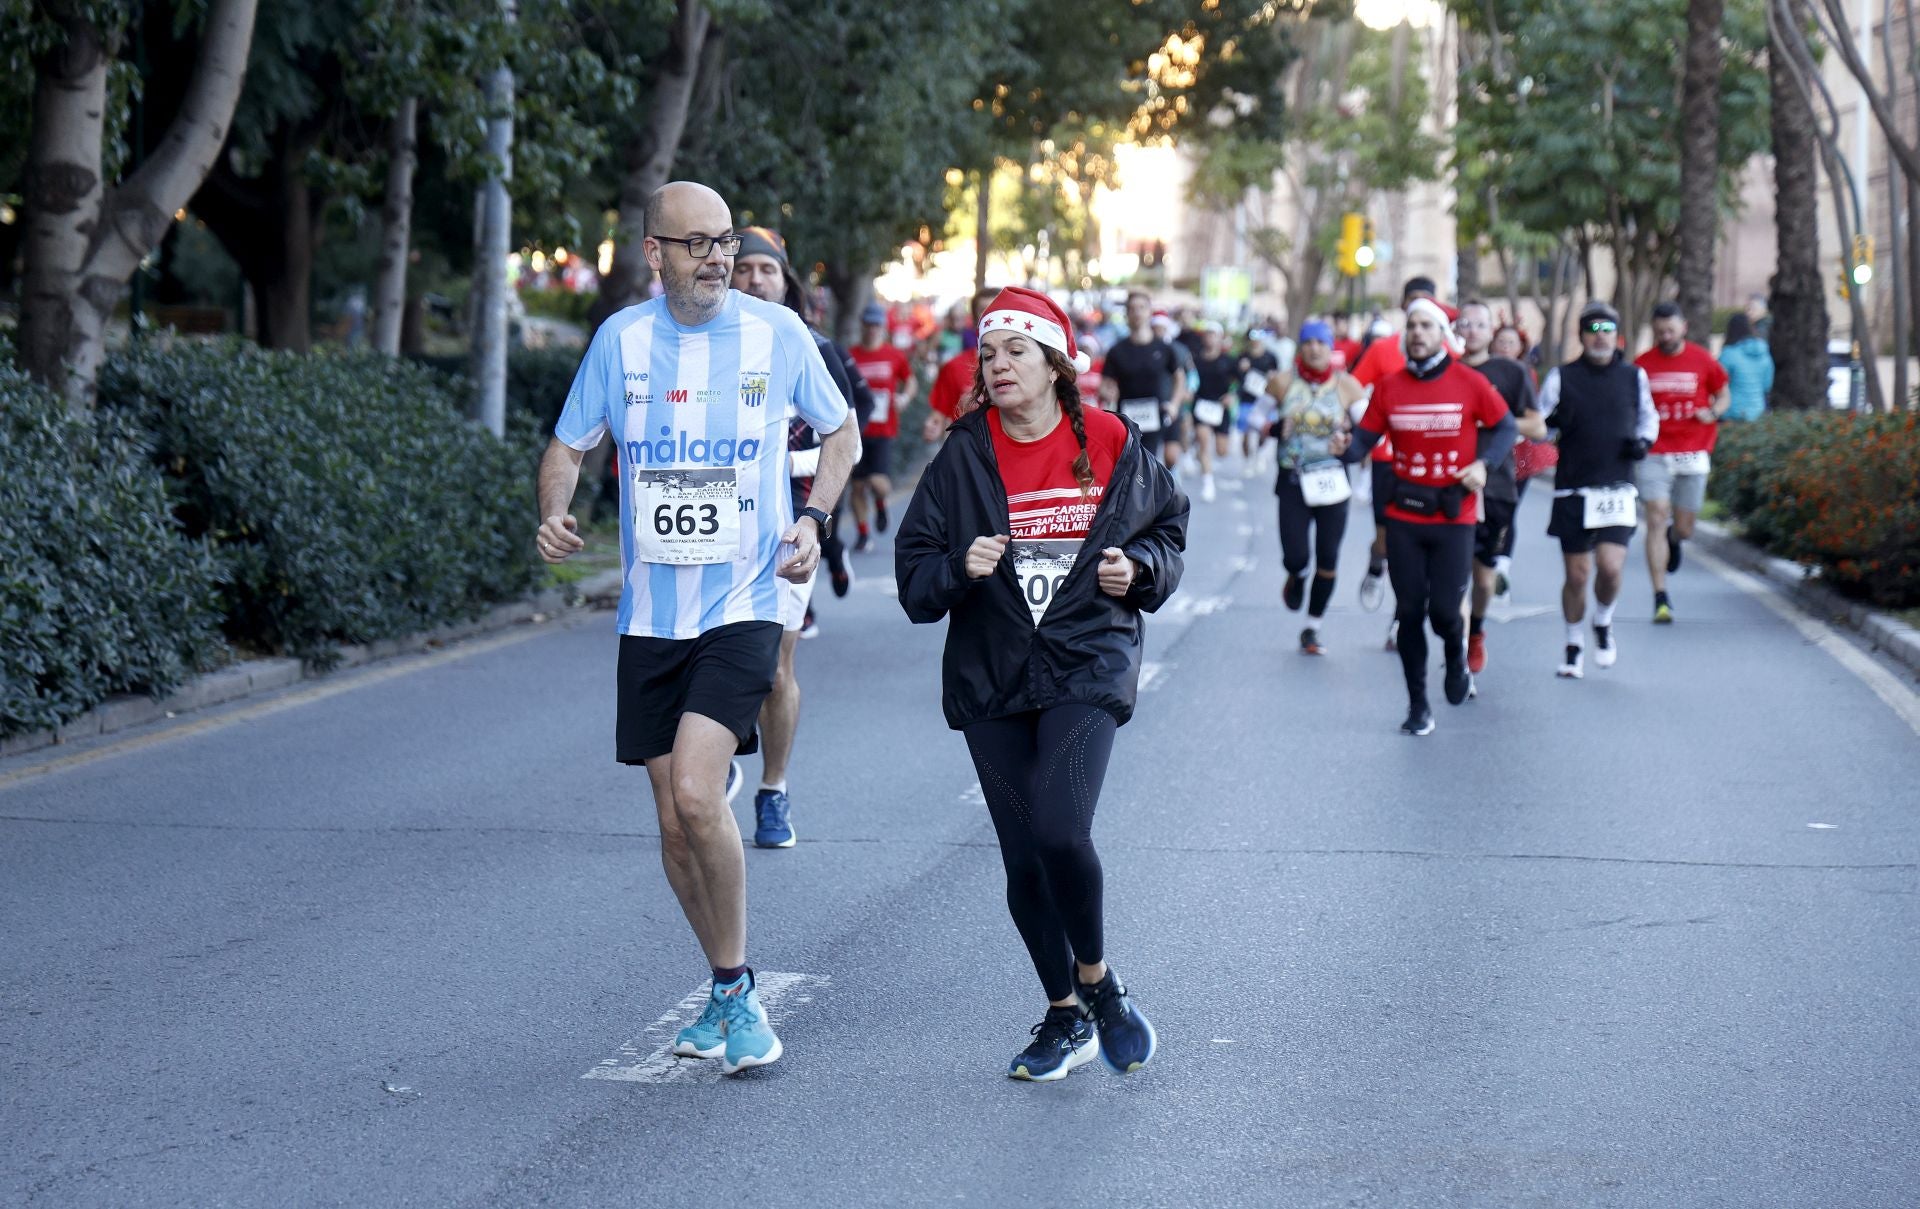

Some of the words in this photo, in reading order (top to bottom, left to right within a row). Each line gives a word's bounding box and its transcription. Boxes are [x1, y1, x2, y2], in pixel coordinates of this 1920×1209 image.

[623, 371, 649, 382] vive
[738, 495, 755, 513] ón
[1052, 504, 1100, 516] CARRER
[654, 503, 720, 536] 663
[1035, 516, 1054, 526] SAN
[1056, 513, 1095, 523] SILVEST
[1010, 525, 1047, 538] PALMA
[1049, 522, 1090, 533] PALMIL
